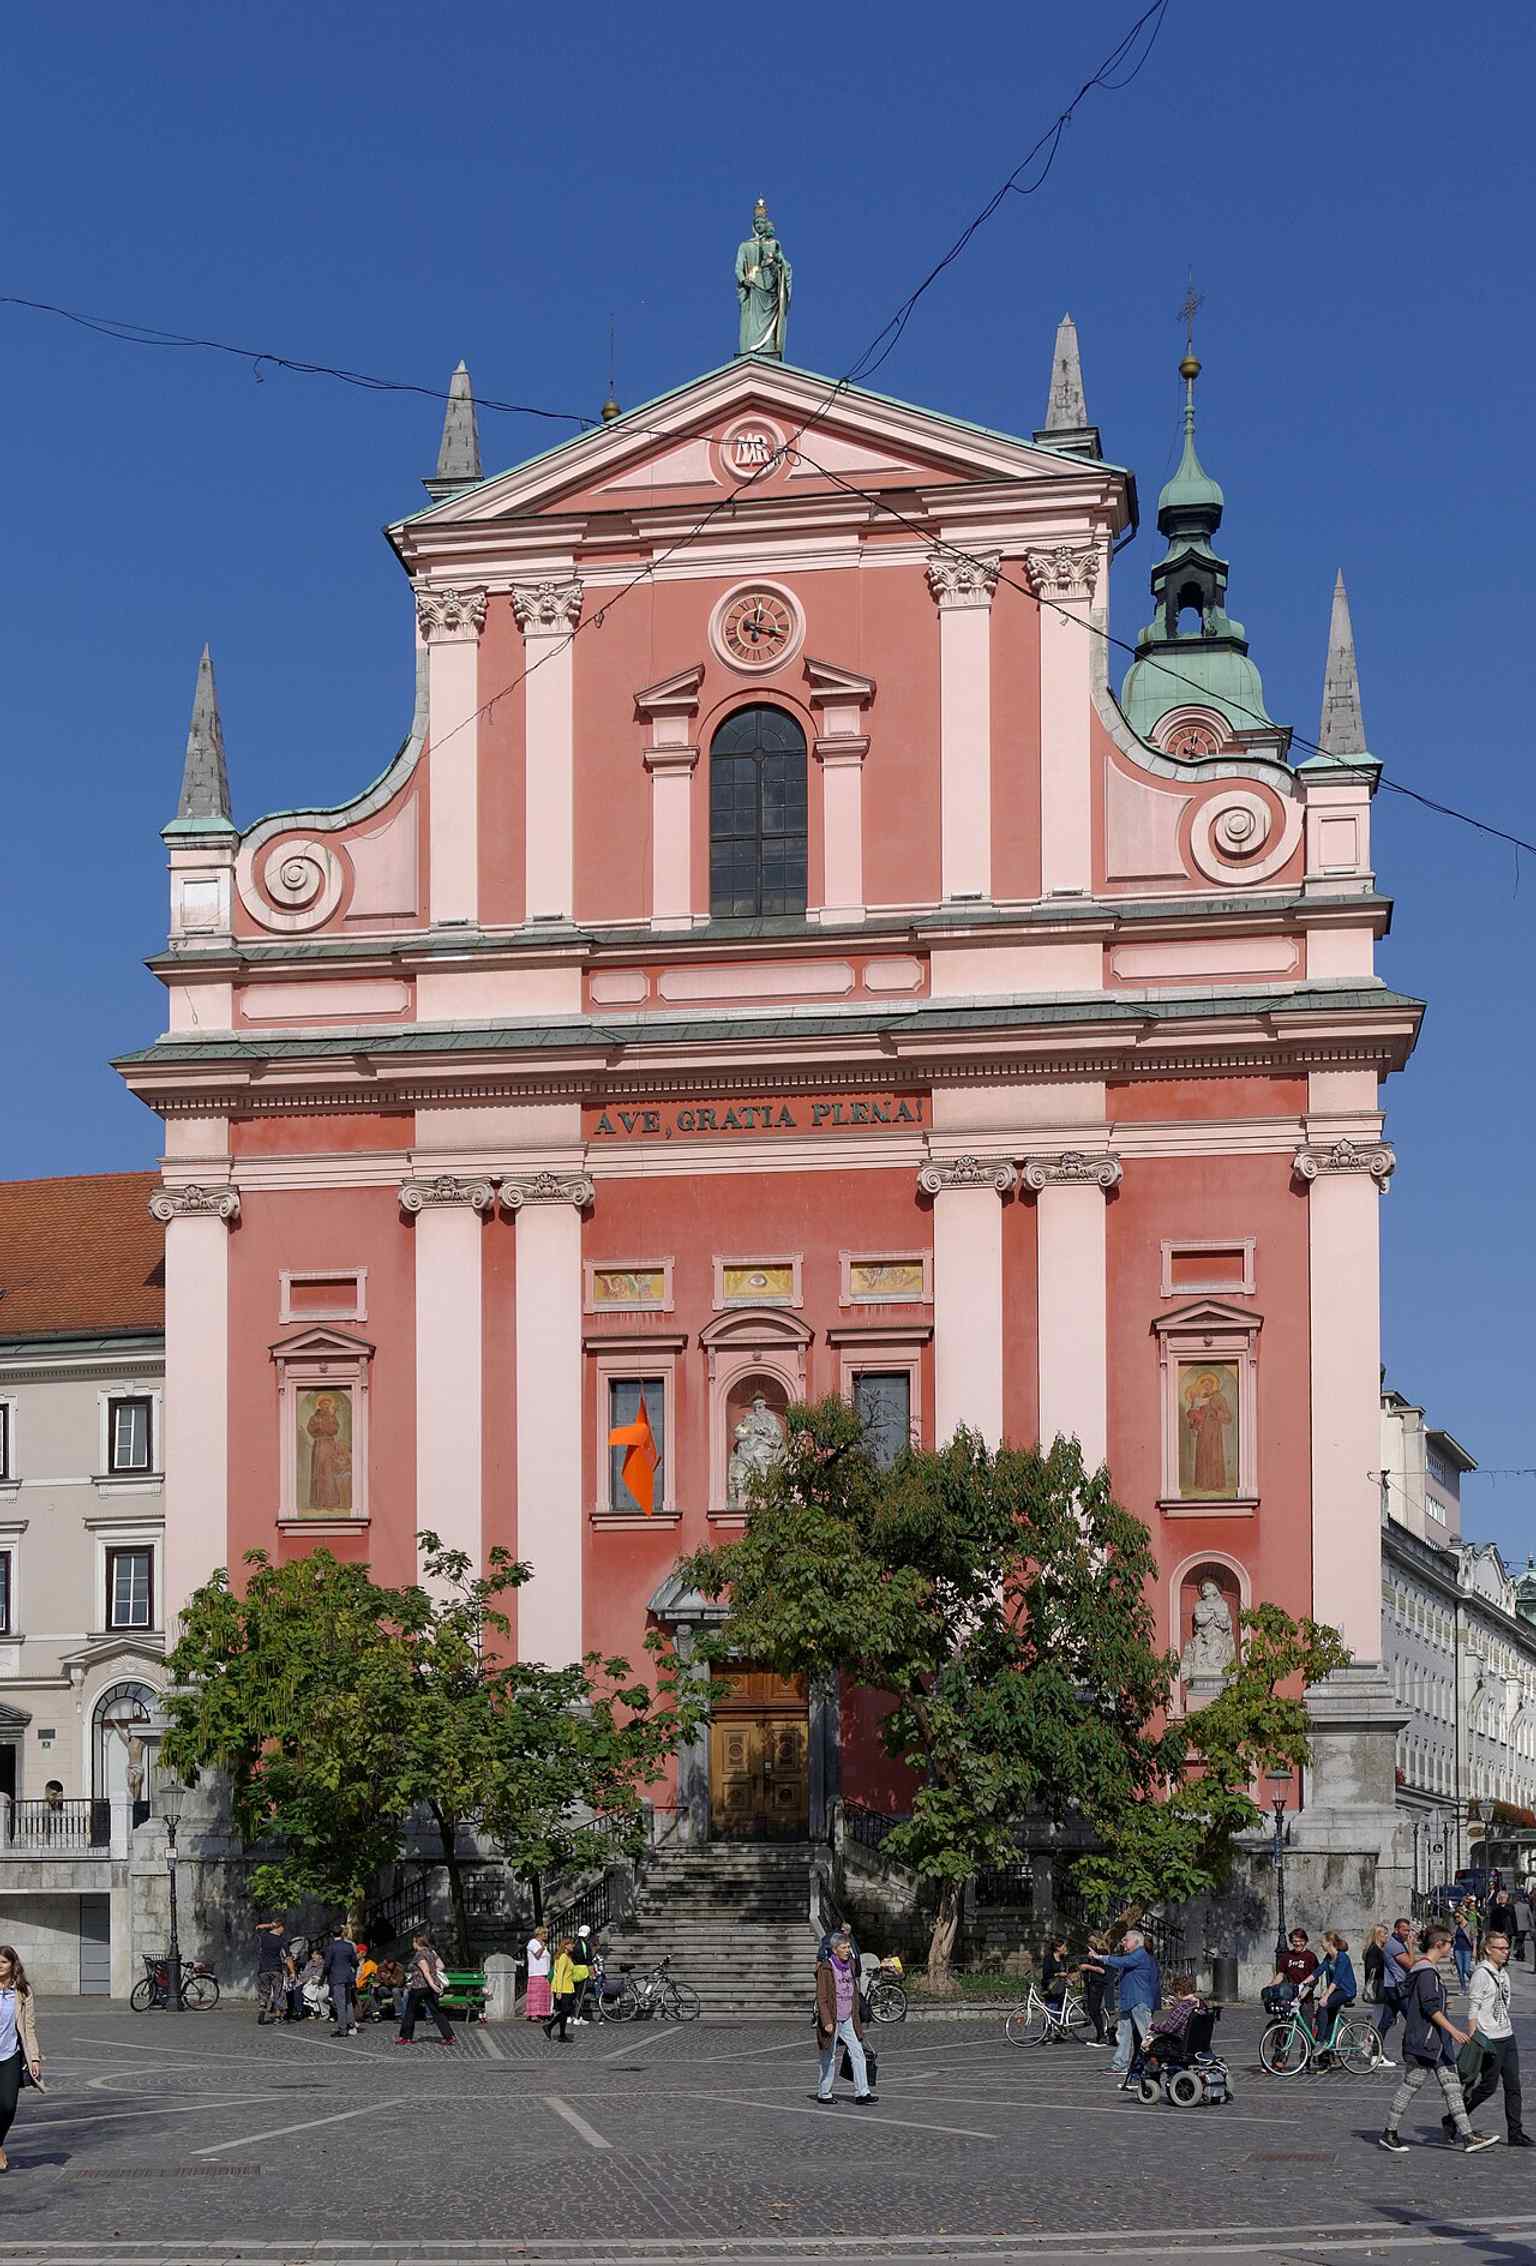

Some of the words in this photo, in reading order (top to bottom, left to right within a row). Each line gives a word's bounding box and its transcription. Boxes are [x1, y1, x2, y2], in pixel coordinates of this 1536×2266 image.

[594, 1110, 672, 1139] AVE,
[677, 1104, 797, 1132] GRATIA
[811, 1097, 923, 1126] PLENA!
